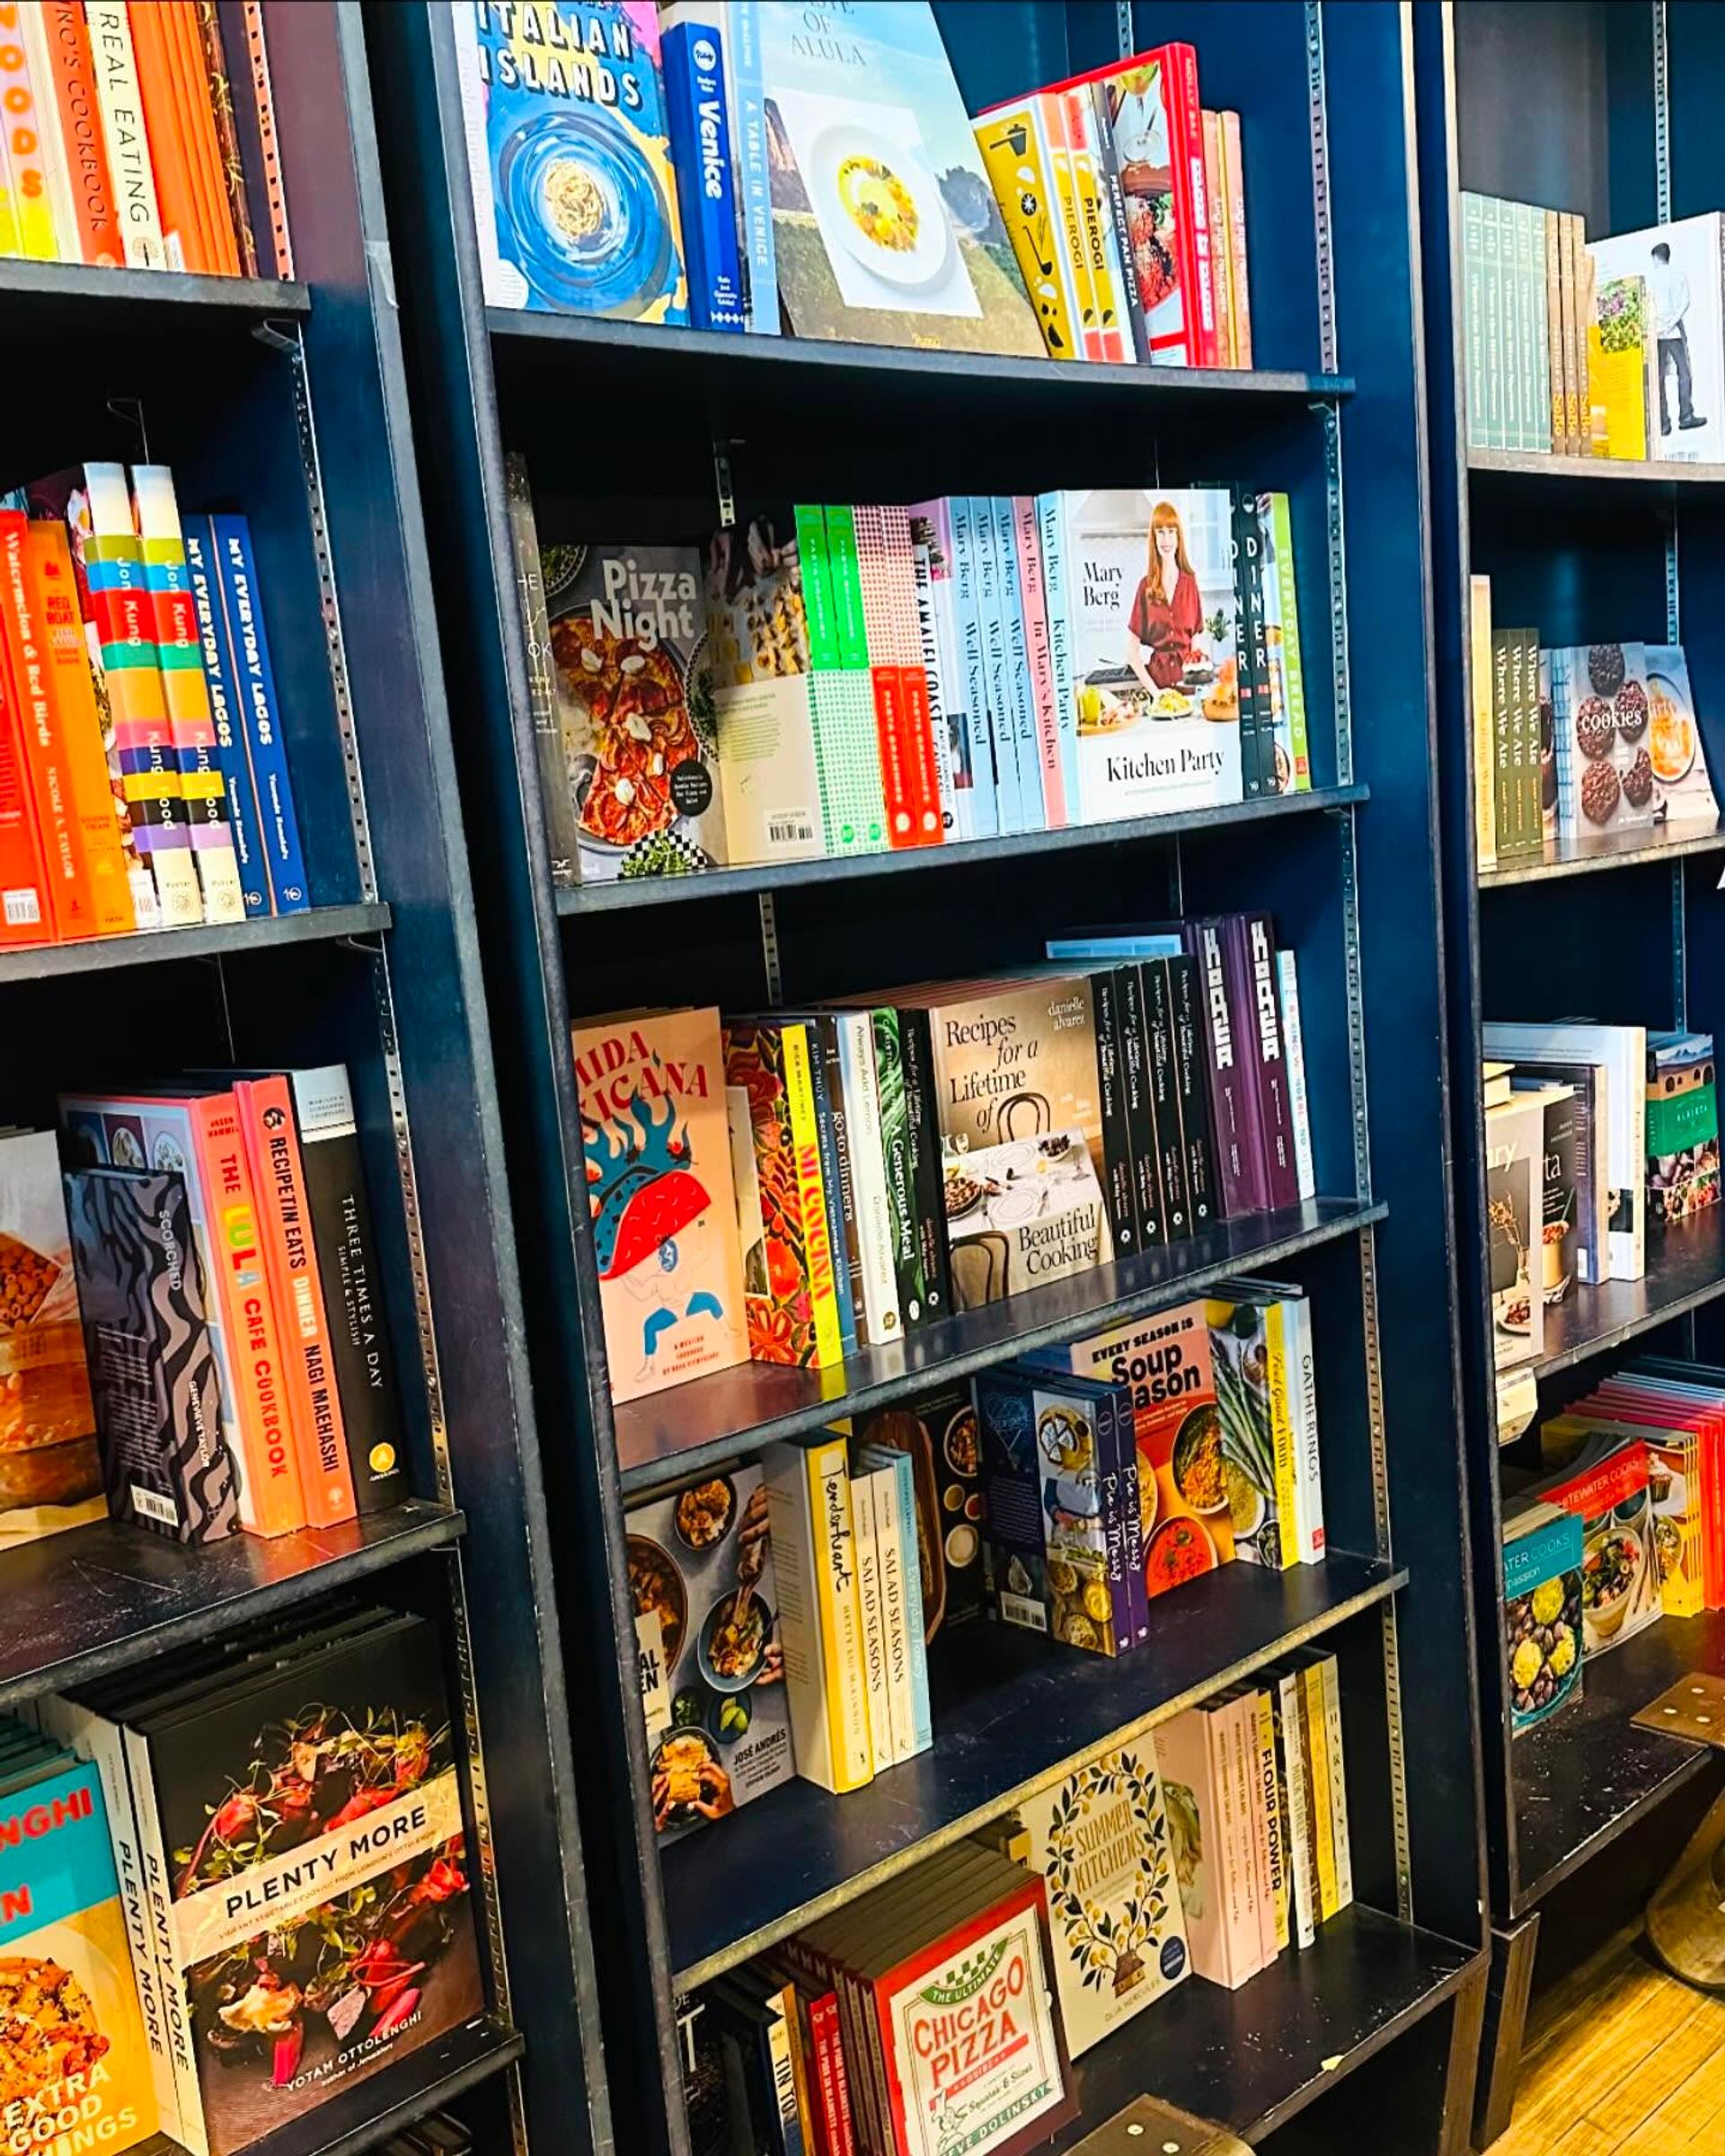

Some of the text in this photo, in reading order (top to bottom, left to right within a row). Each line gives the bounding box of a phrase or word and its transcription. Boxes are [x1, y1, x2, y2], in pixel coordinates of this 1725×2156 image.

[477, 2, 634, 59] ITALIAN
[100, 12, 150, 224] REAL EATING
[481, 46, 643, 110] ISLANDS
[68, 79, 108, 231] COOKBOOK
[698, 101, 722, 199] Venice
[746, 101, 767, 266] A TABLE IN VENICE
[1064, 196, 1084, 270] PIEROGI
[1084, 197, 1104, 270] PIEROGI
[1110, 175, 1138, 306] PERFECT PAN PIZZA
[1022, 510, 1033, 551] Mary
[5, 532, 32, 641] Watermelon
[116, 556, 142, 648] Jon Kung
[164, 559, 190, 649] Jon Kung
[602, 559, 697, 601] Pizza
[1027, 556, 1037, 594] Berg
[1083, 561, 1123, 588] Mary
[1084, 587, 1120, 611] Berg
[1246, 536, 1267, 667] DINNER
[187, 537, 233, 748] MY EVERYDAY LAGOS
[228, 537, 273, 746] MY EVERYDAY LAGOS
[589, 598, 694, 652] Night
[914, 558, 943, 722] THE AMALFI COAST
[954, 513, 986, 746] Mary Berg Well Seasoned
[978, 511, 1012, 743] Mary Berg Well Seasoned
[999, 510, 1033, 740] Mary Berg Well Seasoned
[1032, 620, 1044, 638] In
[1044, 507, 1069, 731] Mary Berg Kitchen Party
[25, 665, 44, 697] Red
[1498, 646, 1508, 769] Where We Are
[1513, 644, 1524, 766] Where We Are
[1527, 644, 1539, 766] Where We Are
[32, 701, 53, 747] Birds
[1042, 704, 1057, 770] Kitchen
[1106, 748, 1225, 782] Kitchen Party
[944, 1013, 1017, 1048] Recipes
[996, 1037, 1039, 1073] for a
[949, 1066, 1027, 1105] Lifetime
[975, 1096, 999, 1135] of
[837, 1155, 854, 1223] dinners
[891, 1138, 910, 1218] Generous
[158, 1209, 182, 1292] SCORCHED
[797, 1142, 833, 1302] MI COCINA
[900, 1221, 916, 1260] Meal
[1018, 1203, 1097, 1253] Beautiful
[1026, 1235, 1099, 1275] Cooking
[219, 1153, 288, 1478] THE LULA CAFE COOKBOOK
[270, 1135, 340, 1473] RECIPETIN EATS DINNER NAGI MAEHASHI
[341, 1193, 384, 1389] THREE TIMES A DAY
[1092, 1317, 1194, 1364] EVERY SEASON IS
[1111, 1344, 1182, 1388] Soup
[1302, 1355, 1320, 1482] GATHERINGS
[862, 1556, 882, 1693] SALAD SEASONS
[885, 1548, 905, 1684] SALAD SEASONS
[226, 1805, 428, 1919] PLENTY MORE
[1073, 1825, 1147, 1895] KITCHENS
[1075, 1798, 1136, 1857] SUMMER
[1261, 1749, 1283, 1892] FLOUR POWER
[119, 1840, 147, 1957] PLENTY
[139, 1968, 164, 2057] MORE
[146, 1853, 190, 2072] PLENTY MORE
[913, 1954, 1025, 2058] CHICAGO
[287, 2010, 423, 2093] YOTAM OTTOLENGHI
[774, 2054, 797, 2115] TIN TO
[930, 2010, 1018, 2090] PIZZA
[4, 2063, 111, 2130] EXTRA
[8, 2095, 102, 2154] GOOD
